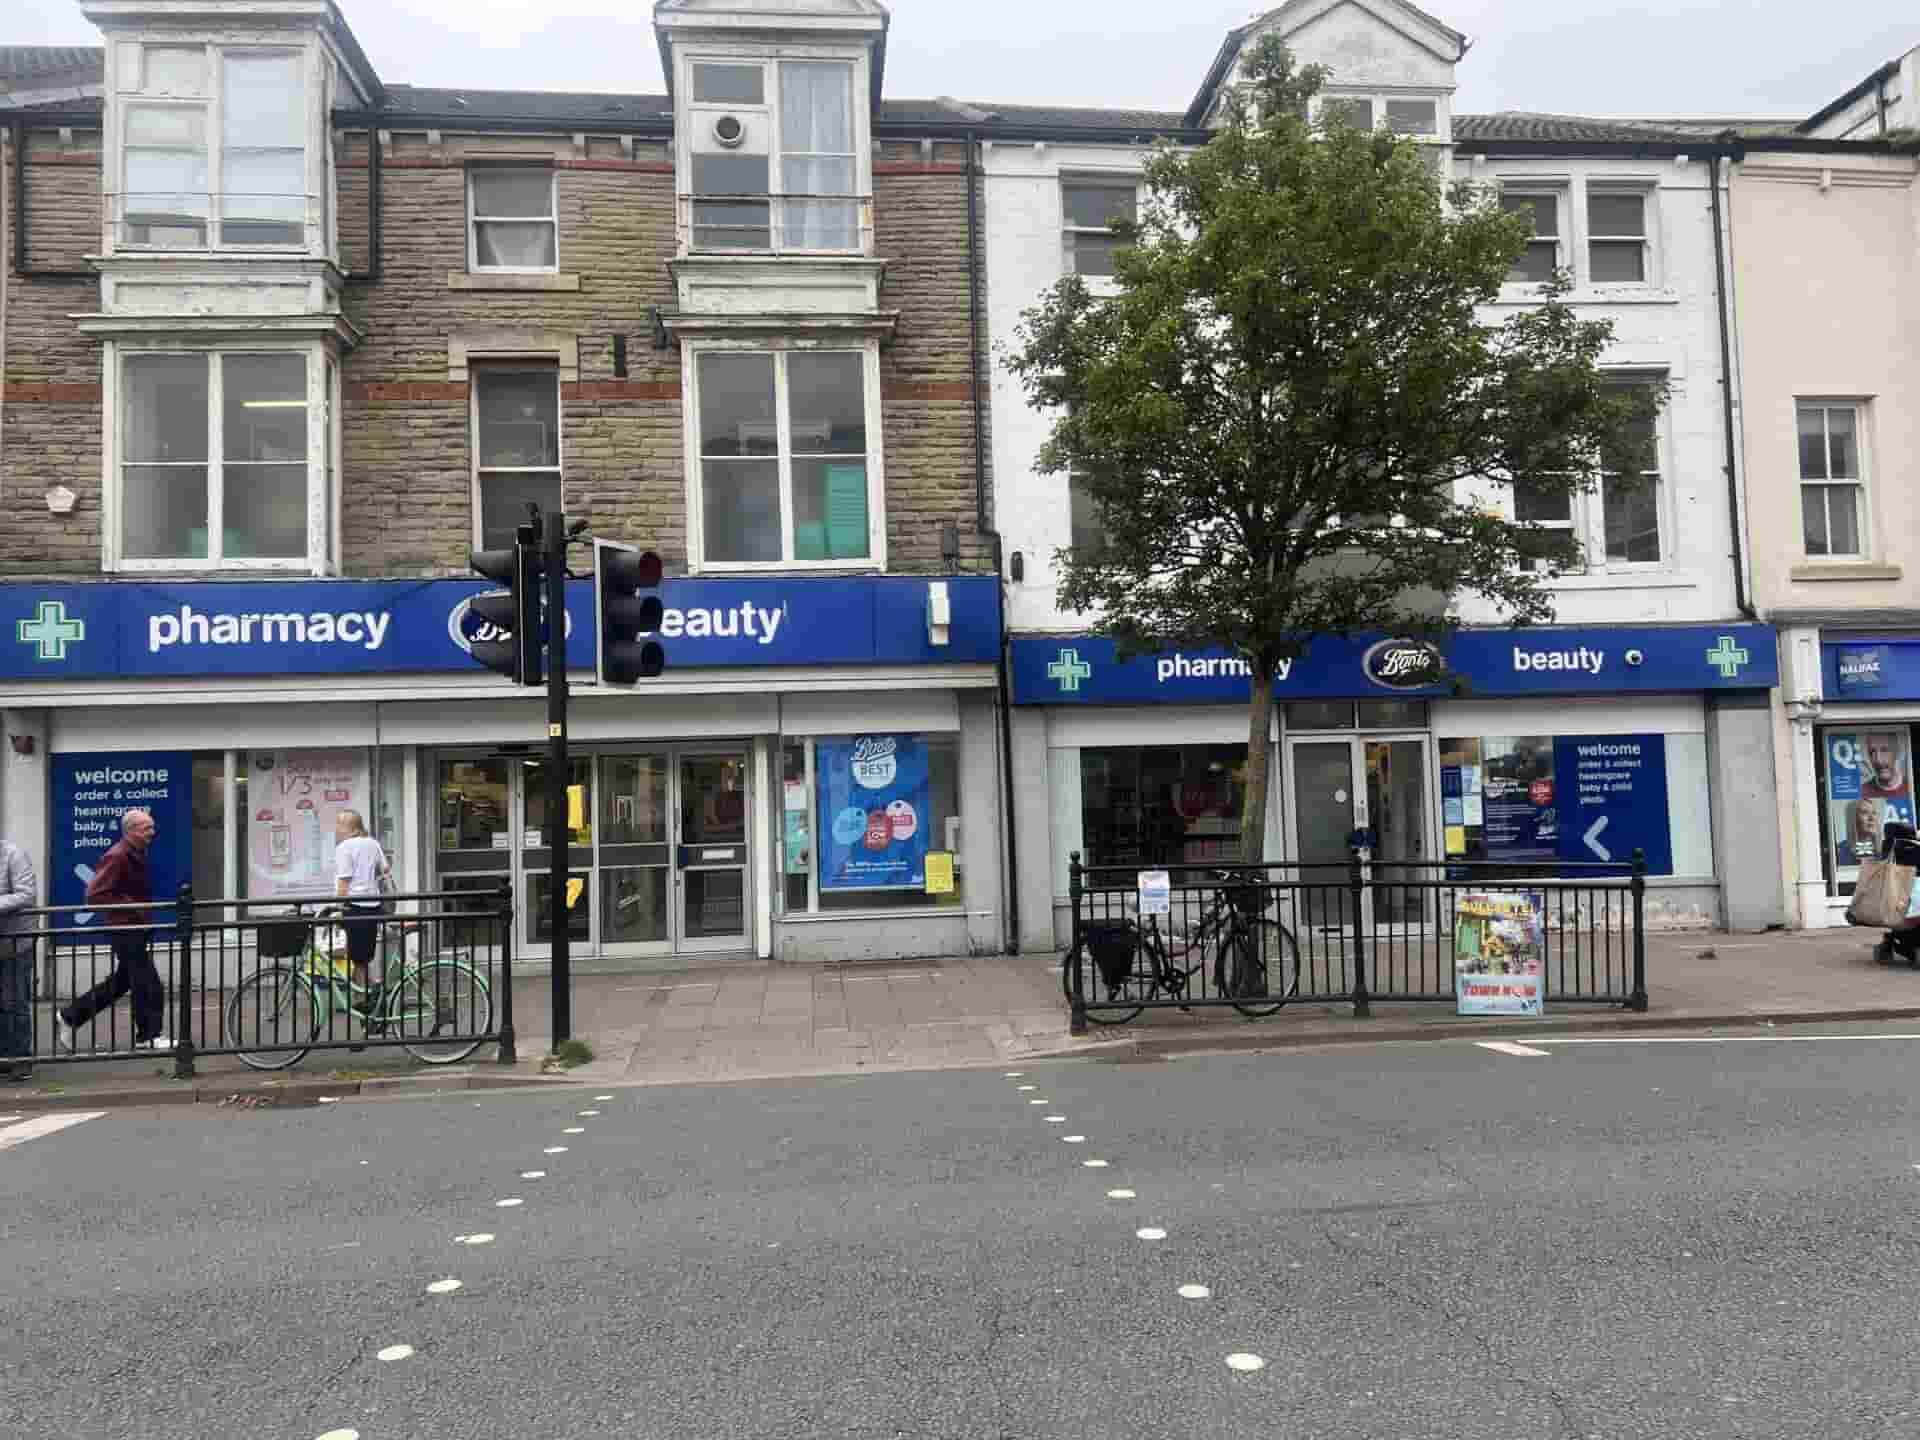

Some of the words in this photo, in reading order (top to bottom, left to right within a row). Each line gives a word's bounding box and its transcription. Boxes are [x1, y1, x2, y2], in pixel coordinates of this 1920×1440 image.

[149, 605, 391, 652] pharmacy
[637, 600, 782, 645] eauty
[1157, 654, 1292, 682] pharmy
[1376, 648, 1432, 677] Boots
[1513, 647, 1604, 674] beauty
[1577, 743, 1641, 757] welcome
[75, 766, 169, 785] welcome
[74, 788, 110, 801] order
[126, 787, 169, 799] collect
[74, 820, 106, 833] baby
[74, 837, 112, 850] photo
